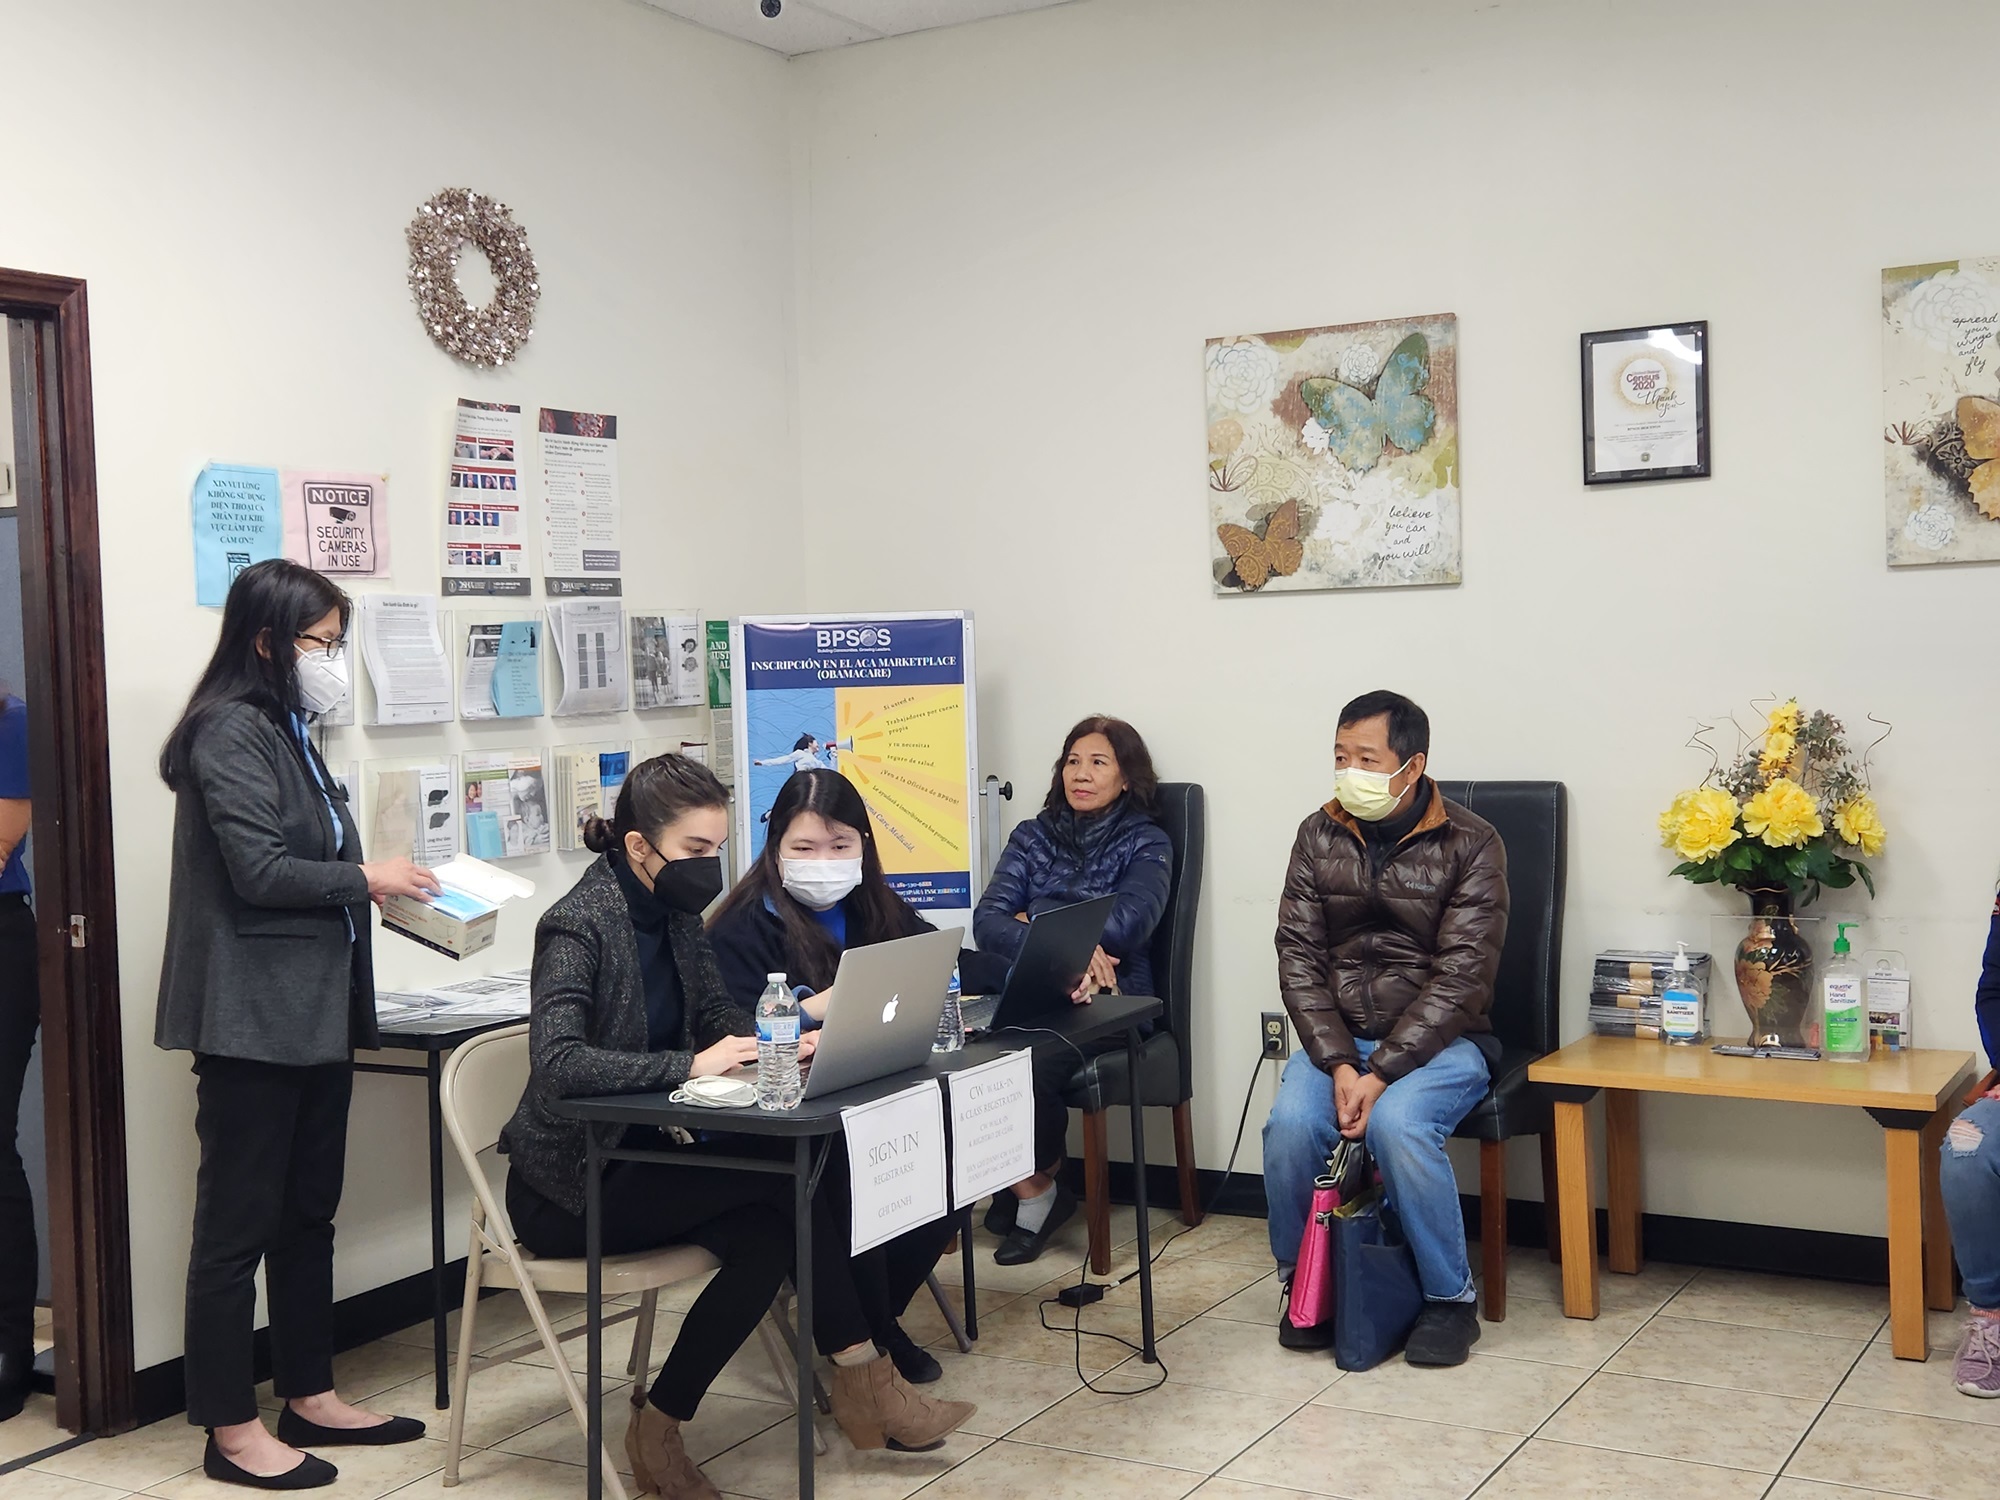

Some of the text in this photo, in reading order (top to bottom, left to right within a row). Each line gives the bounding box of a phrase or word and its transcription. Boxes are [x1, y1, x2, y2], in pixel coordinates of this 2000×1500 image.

[1953, 313, 1998, 328] spread
[1965, 326, 1989, 339] your
[1956, 332, 1994, 349] wings
[1958, 346, 1977, 356] and
[1965, 356, 1986, 376] fly
[1626, 373, 1660, 382] Census
[1633, 381, 1655, 390] 2020
[208, 489, 235, 498] KHÔNG
[311, 489, 367, 504] NOTICE
[212, 511, 232, 520] NHÂN
[235, 514, 247, 522] TẠI
[1389, 505, 1433, 518] believe
[317, 526, 364, 539] SECURITY
[1384, 522, 1426, 536] you can
[1393, 535, 1411, 545] and
[318, 541, 367, 553] CAMERAS
[328, 555, 360, 567] IN USE
[1378, 543, 1432, 570] you will
[817, 628, 891, 647] BPSOS
[710, 641, 727, 650] AND
[752, 656, 956, 671] INSCRIPCIÓN EN EL ACA MARKETPLACE
[817, 668, 892, 680] (OBAMACARE)
[886, 713, 925, 725] Trabajadores
[907, 780, 928, 793] Oficina
[970, 1084, 983, 1100] CW
[966, 1106, 982, 1119] CLASS
[984, 1091, 1023, 1112] REGISTRATION
[869, 1131, 920, 1167] SIGN IN
[874, 1161, 915, 1186] REGISTRARSE
[878, 1195, 912, 1218] GHI DANH
